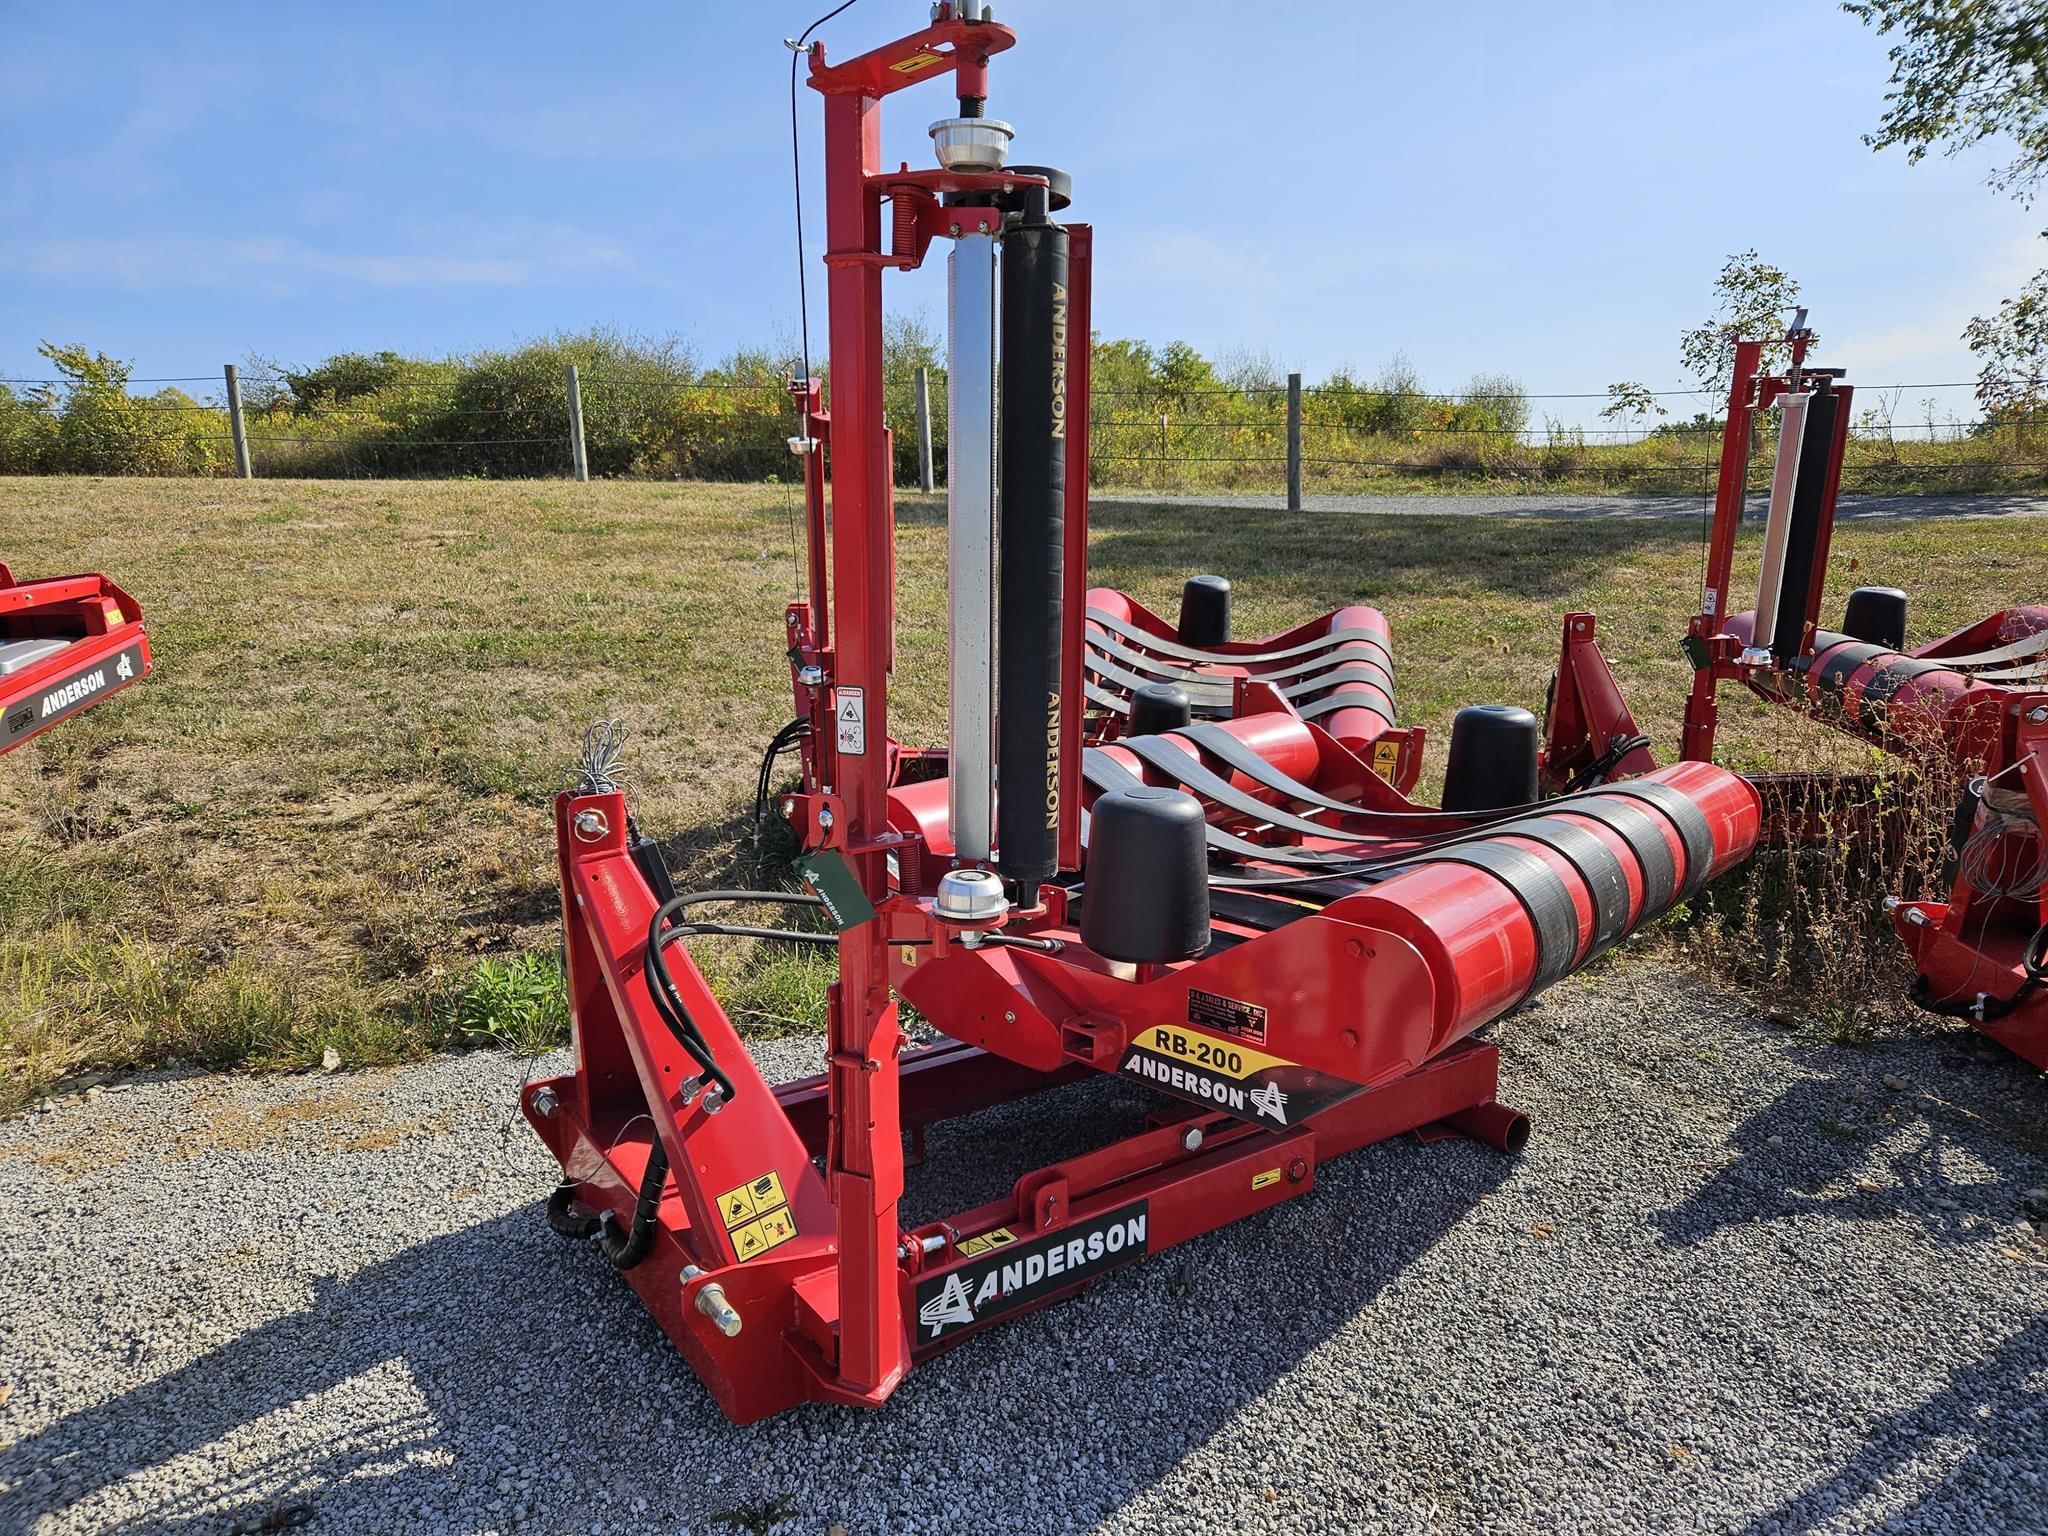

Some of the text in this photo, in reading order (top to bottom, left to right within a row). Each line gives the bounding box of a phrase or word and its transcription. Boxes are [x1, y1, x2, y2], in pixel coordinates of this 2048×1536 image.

[1052, 281, 1068, 439] ANDERSON
[41, 669, 106, 718] ANDERSON
[1046, 690, 1060, 831] ANDERSON
[816, 887, 844, 927] ANDERSON
[1154, 1028, 1243, 1075] RB-200
[1125, 1054, 1245, 1111] ANDERSON
[974, 1214, 1146, 1313] ANDERSON
